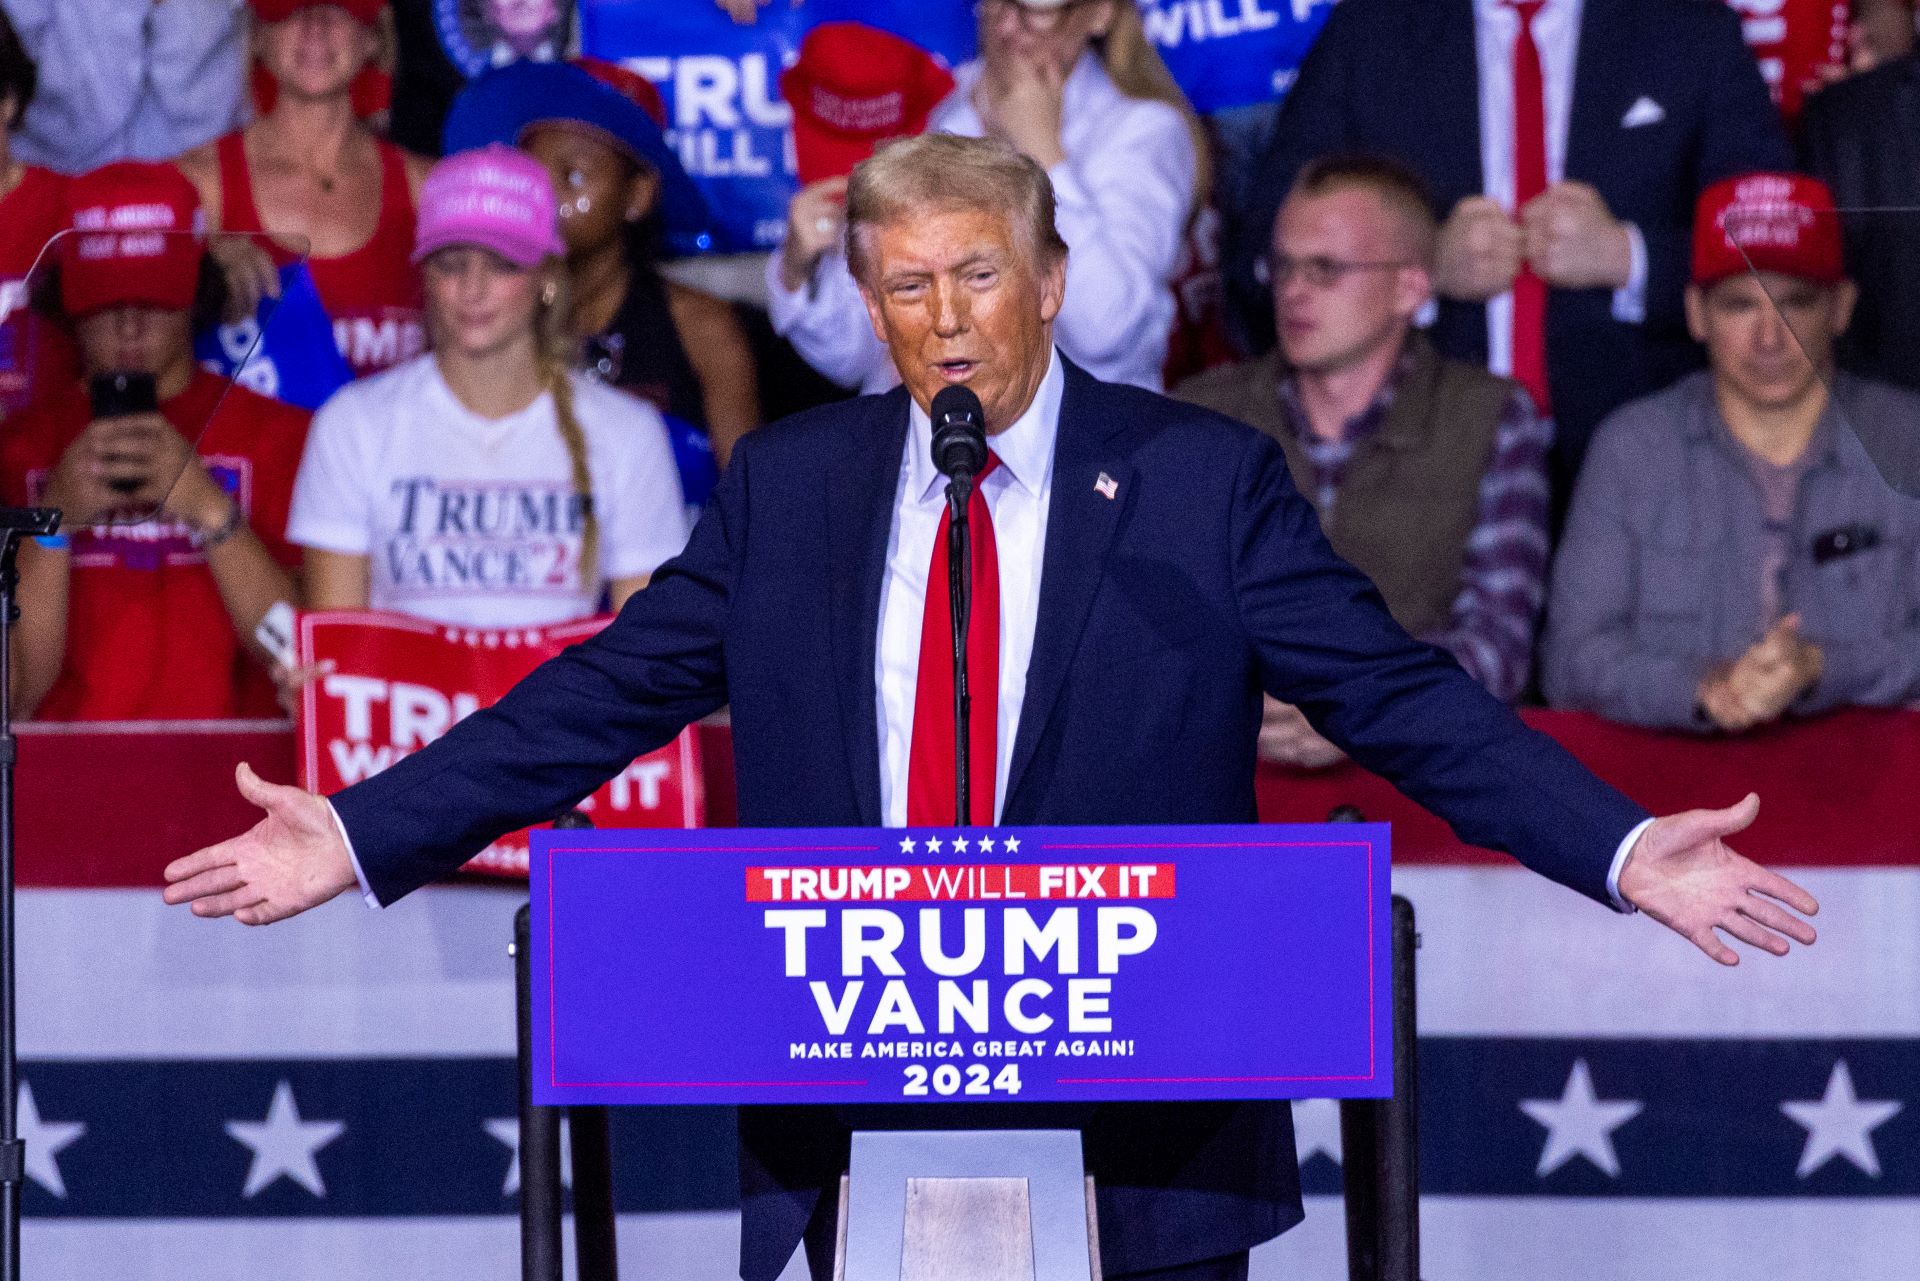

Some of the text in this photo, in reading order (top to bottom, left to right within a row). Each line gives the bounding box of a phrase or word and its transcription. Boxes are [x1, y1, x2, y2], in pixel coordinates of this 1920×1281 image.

[762, 864, 1159, 901] TRUMP WILL FIX IT
[763, 906, 1159, 978] TRUMP
[808, 977, 1114, 1036] VANCE
[789, 1039, 1135, 1059] MAKE AMERICA GREAT AGAIN!
[902, 1063, 1023, 1097] 2024
